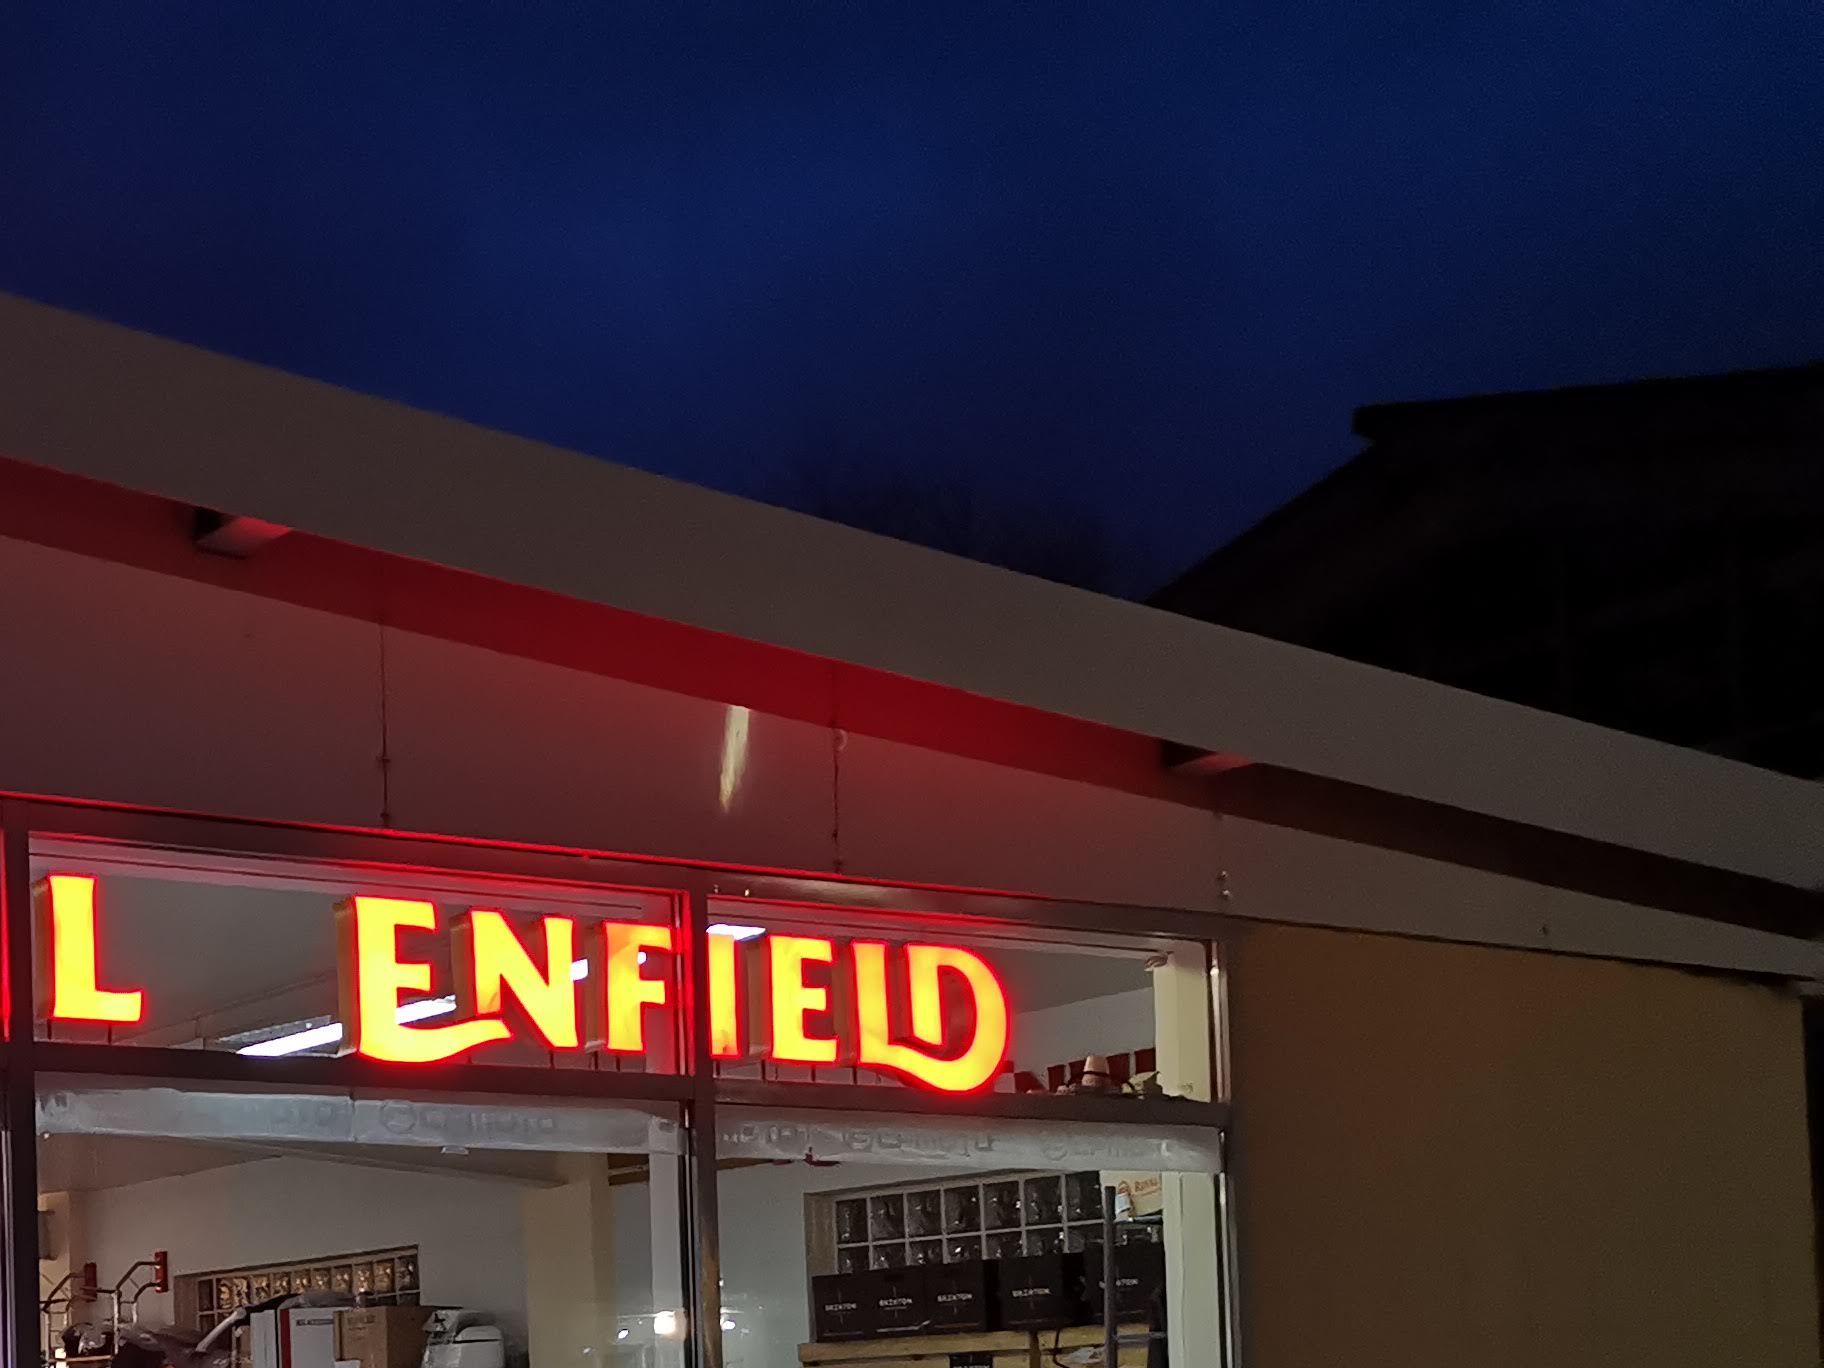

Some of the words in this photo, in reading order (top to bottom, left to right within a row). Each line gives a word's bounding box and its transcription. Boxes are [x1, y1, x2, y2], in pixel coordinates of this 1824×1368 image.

[348, 893, 1010, 1093] ENFIELD
[936, 1292, 974, 1303] BRIXTON
[1012, 1287, 1052, 1298] BRIXTON
[824, 1302, 858, 1312] BRIXTON
[878, 1297, 913, 1307] BRIXTON
